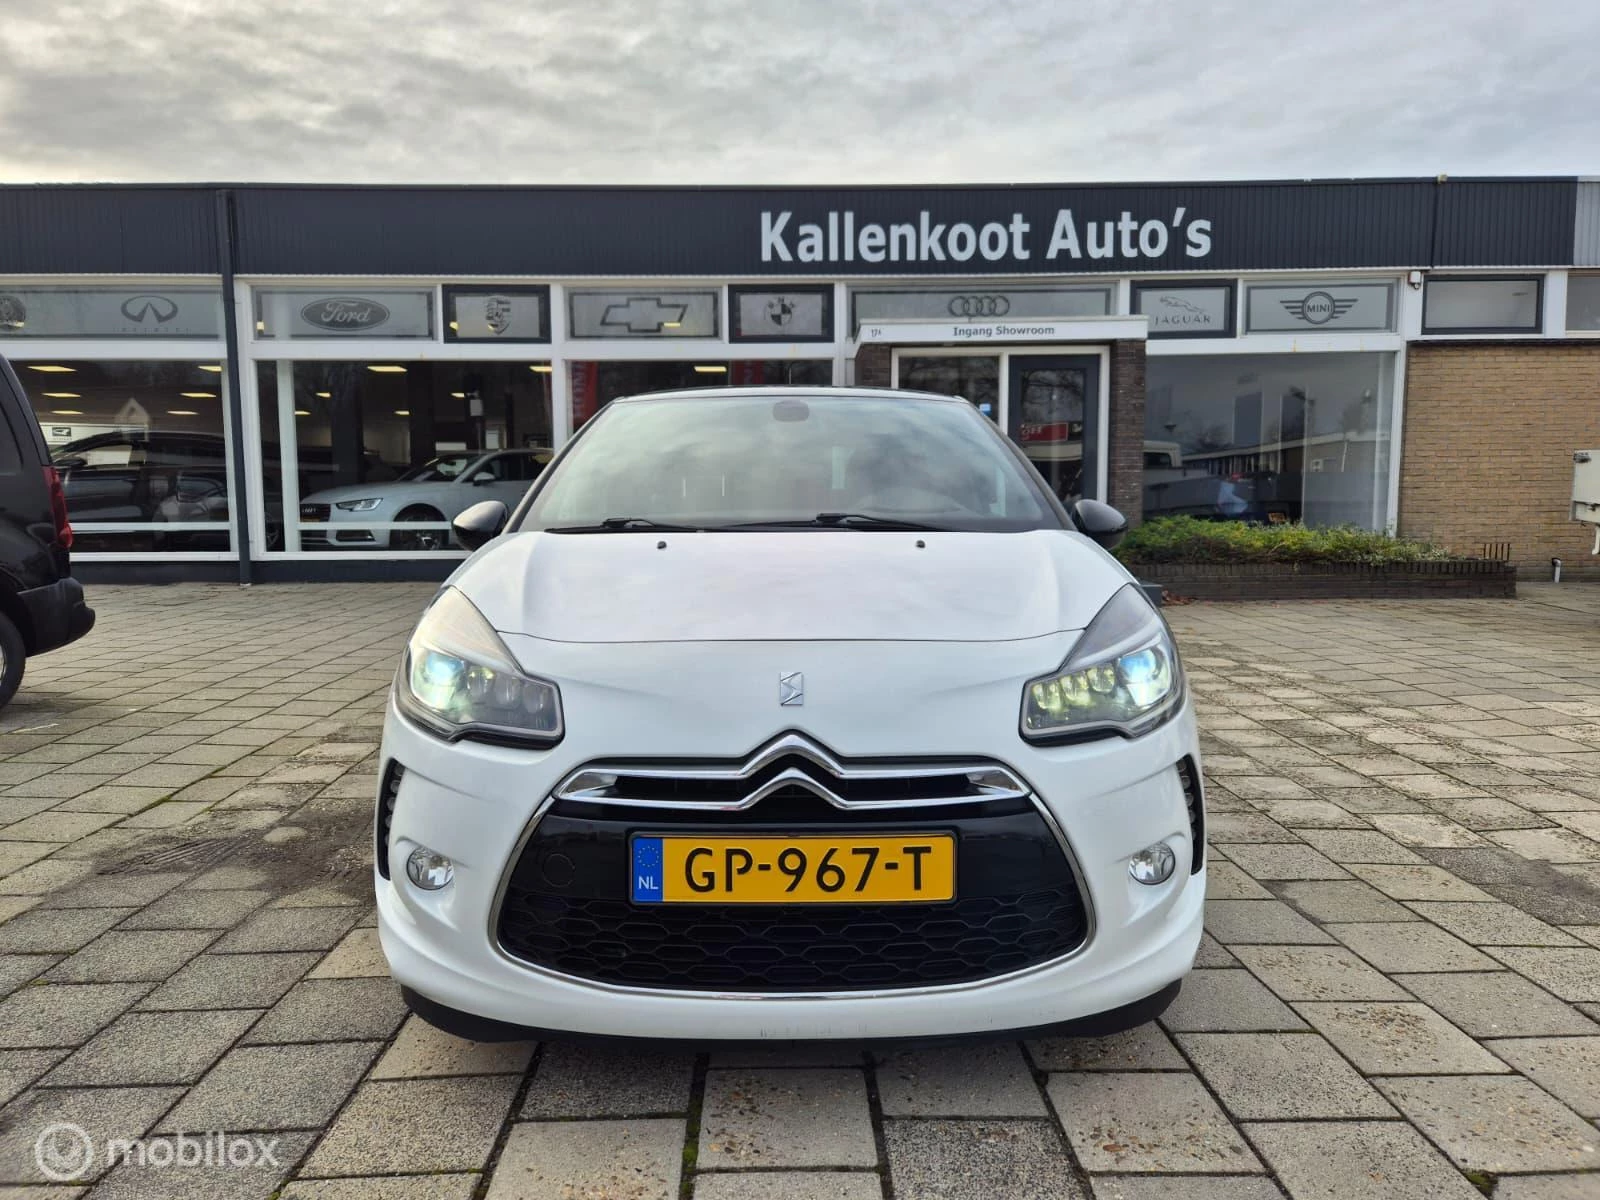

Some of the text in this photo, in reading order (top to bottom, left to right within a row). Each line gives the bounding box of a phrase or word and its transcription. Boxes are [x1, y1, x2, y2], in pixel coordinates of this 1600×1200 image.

[760, 206, 1212, 263] Kallenkoot Auto's
[320, 303, 371, 323] Ford
[1306, 303, 1334, 314] MINI
[1155, 315, 1211, 325] JAGUAR
[953, 325, 1055, 337] Ingang Showroom
[684, 847, 932, 893] GP-967-T
[637, 876, 659, 890] NL
